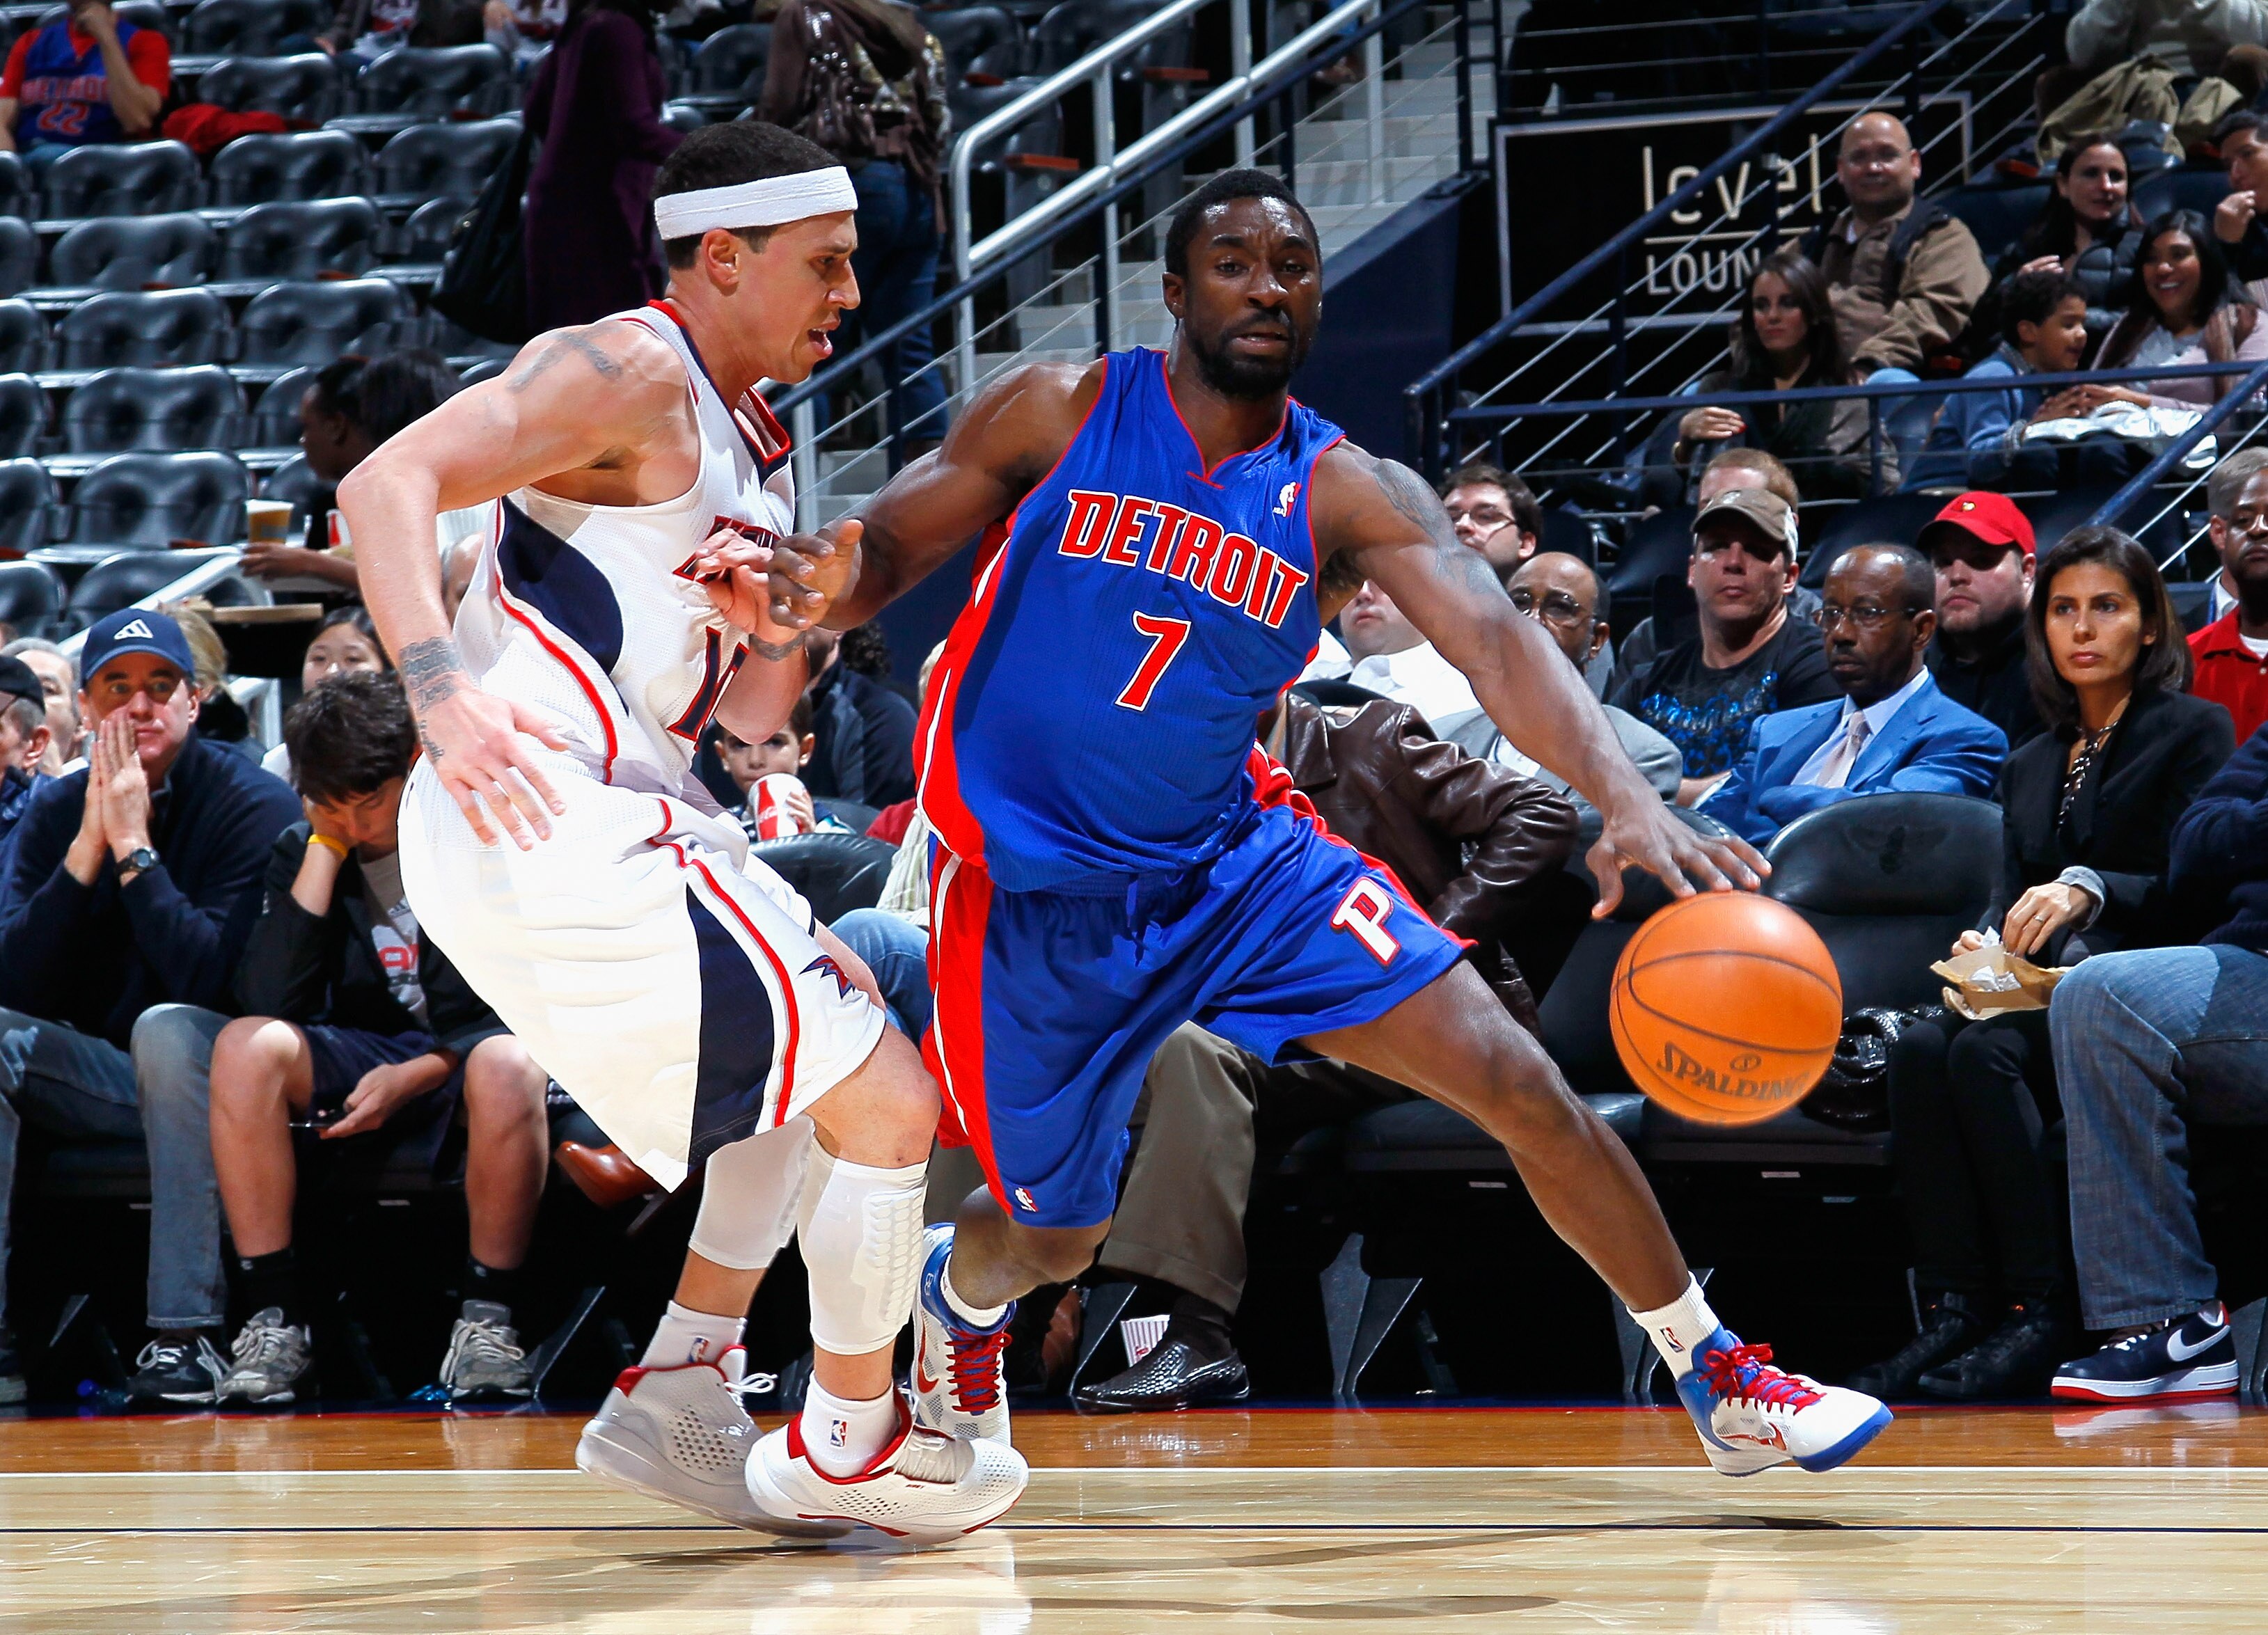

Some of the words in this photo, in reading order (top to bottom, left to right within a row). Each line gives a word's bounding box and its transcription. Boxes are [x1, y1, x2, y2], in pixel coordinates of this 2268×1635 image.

[38, 102, 90, 135] 22
[1642, 132, 1822, 225] level
[1646, 247, 1761, 295] LOUN
[1057, 489, 1309, 629] DETROIT
[1114, 610, 1192, 712] 7
[1330, 876, 1401, 967] P
